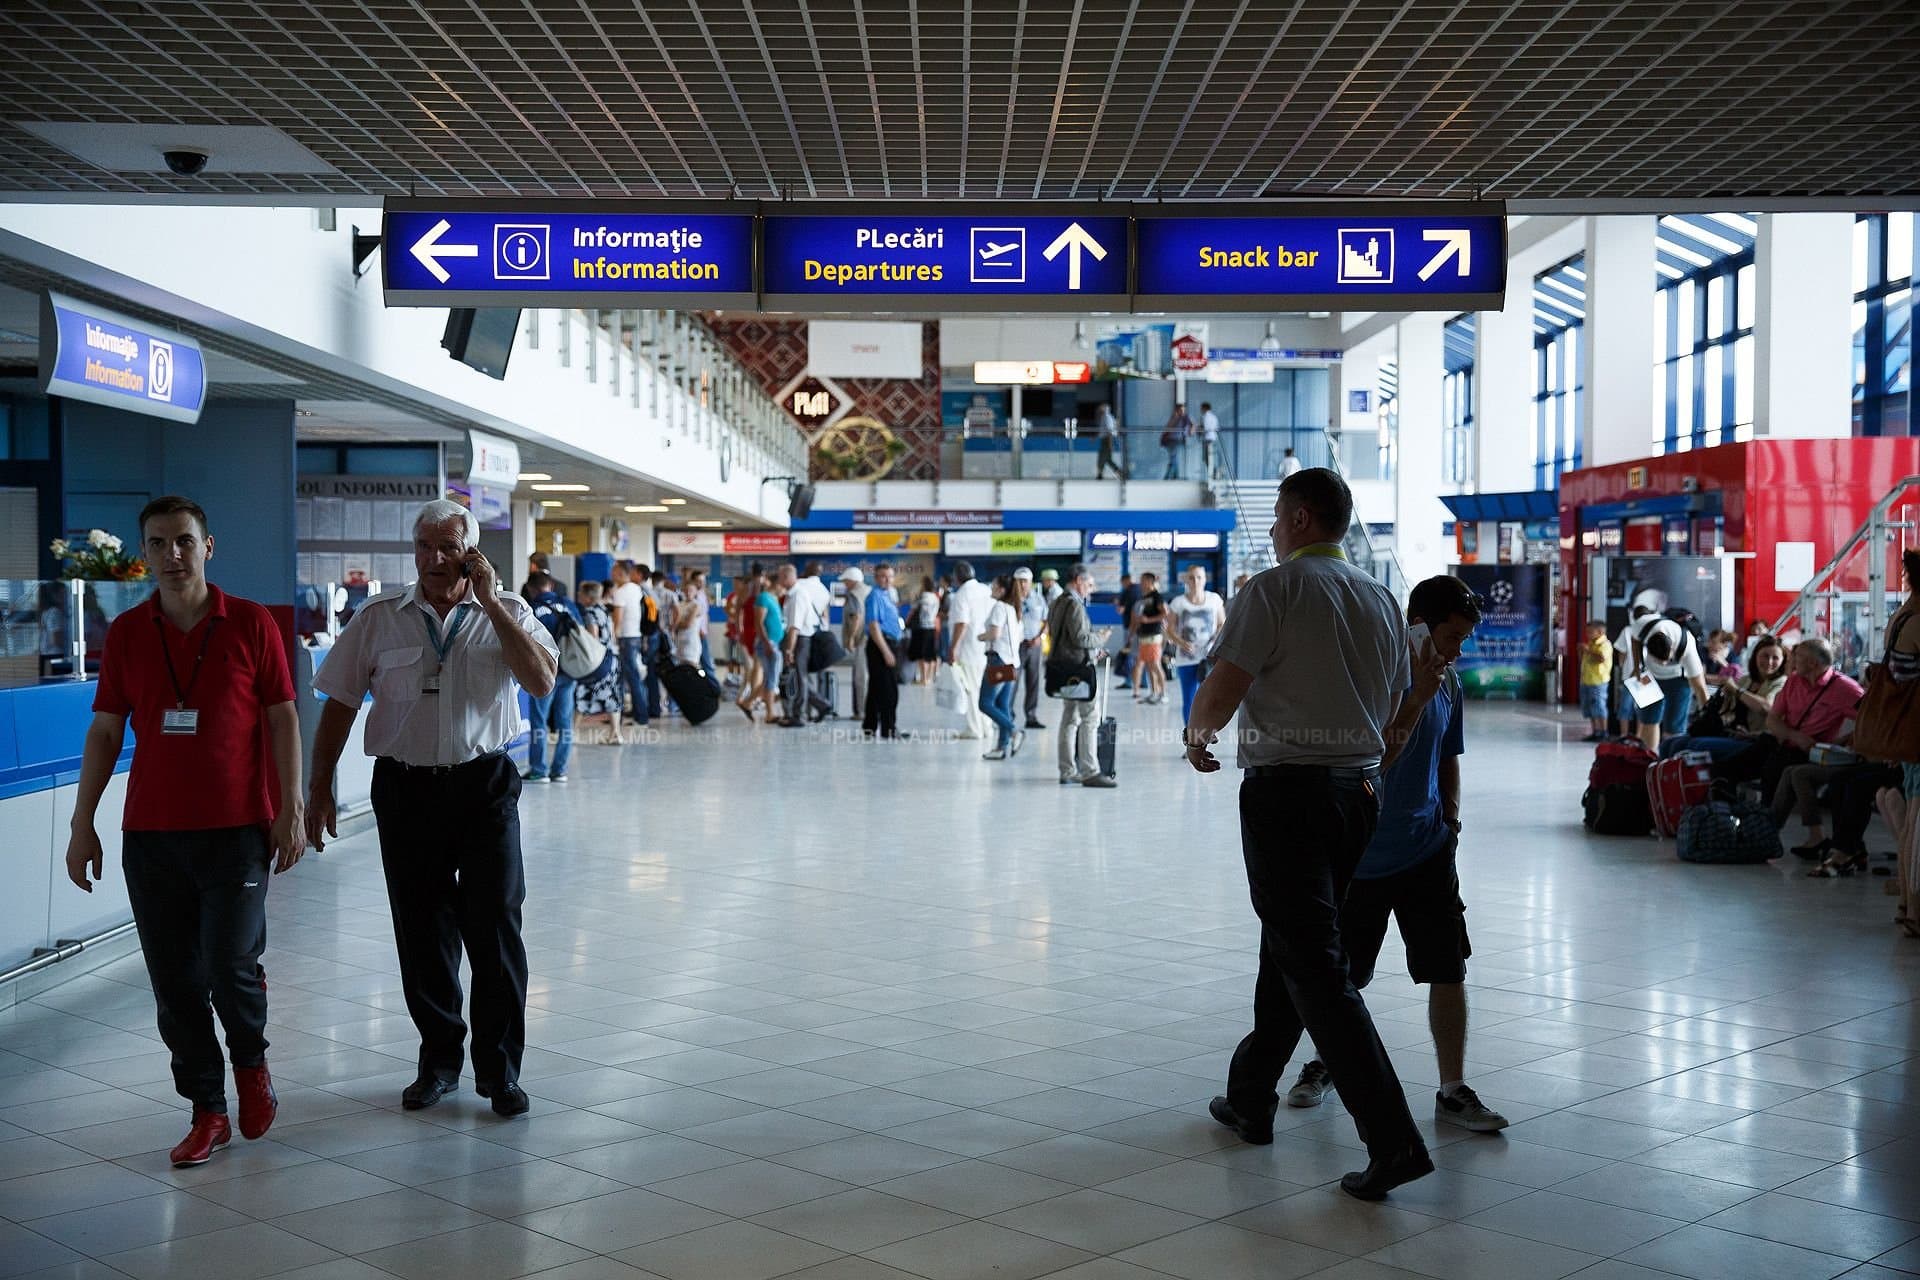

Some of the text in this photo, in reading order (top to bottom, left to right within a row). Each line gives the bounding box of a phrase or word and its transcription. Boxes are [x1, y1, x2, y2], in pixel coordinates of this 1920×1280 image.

[573, 258, 720, 280] Information
[1199, 246, 1319, 268] Snack bar
[803, 259, 944, 286] Departures
[84, 356, 144, 393] Information
